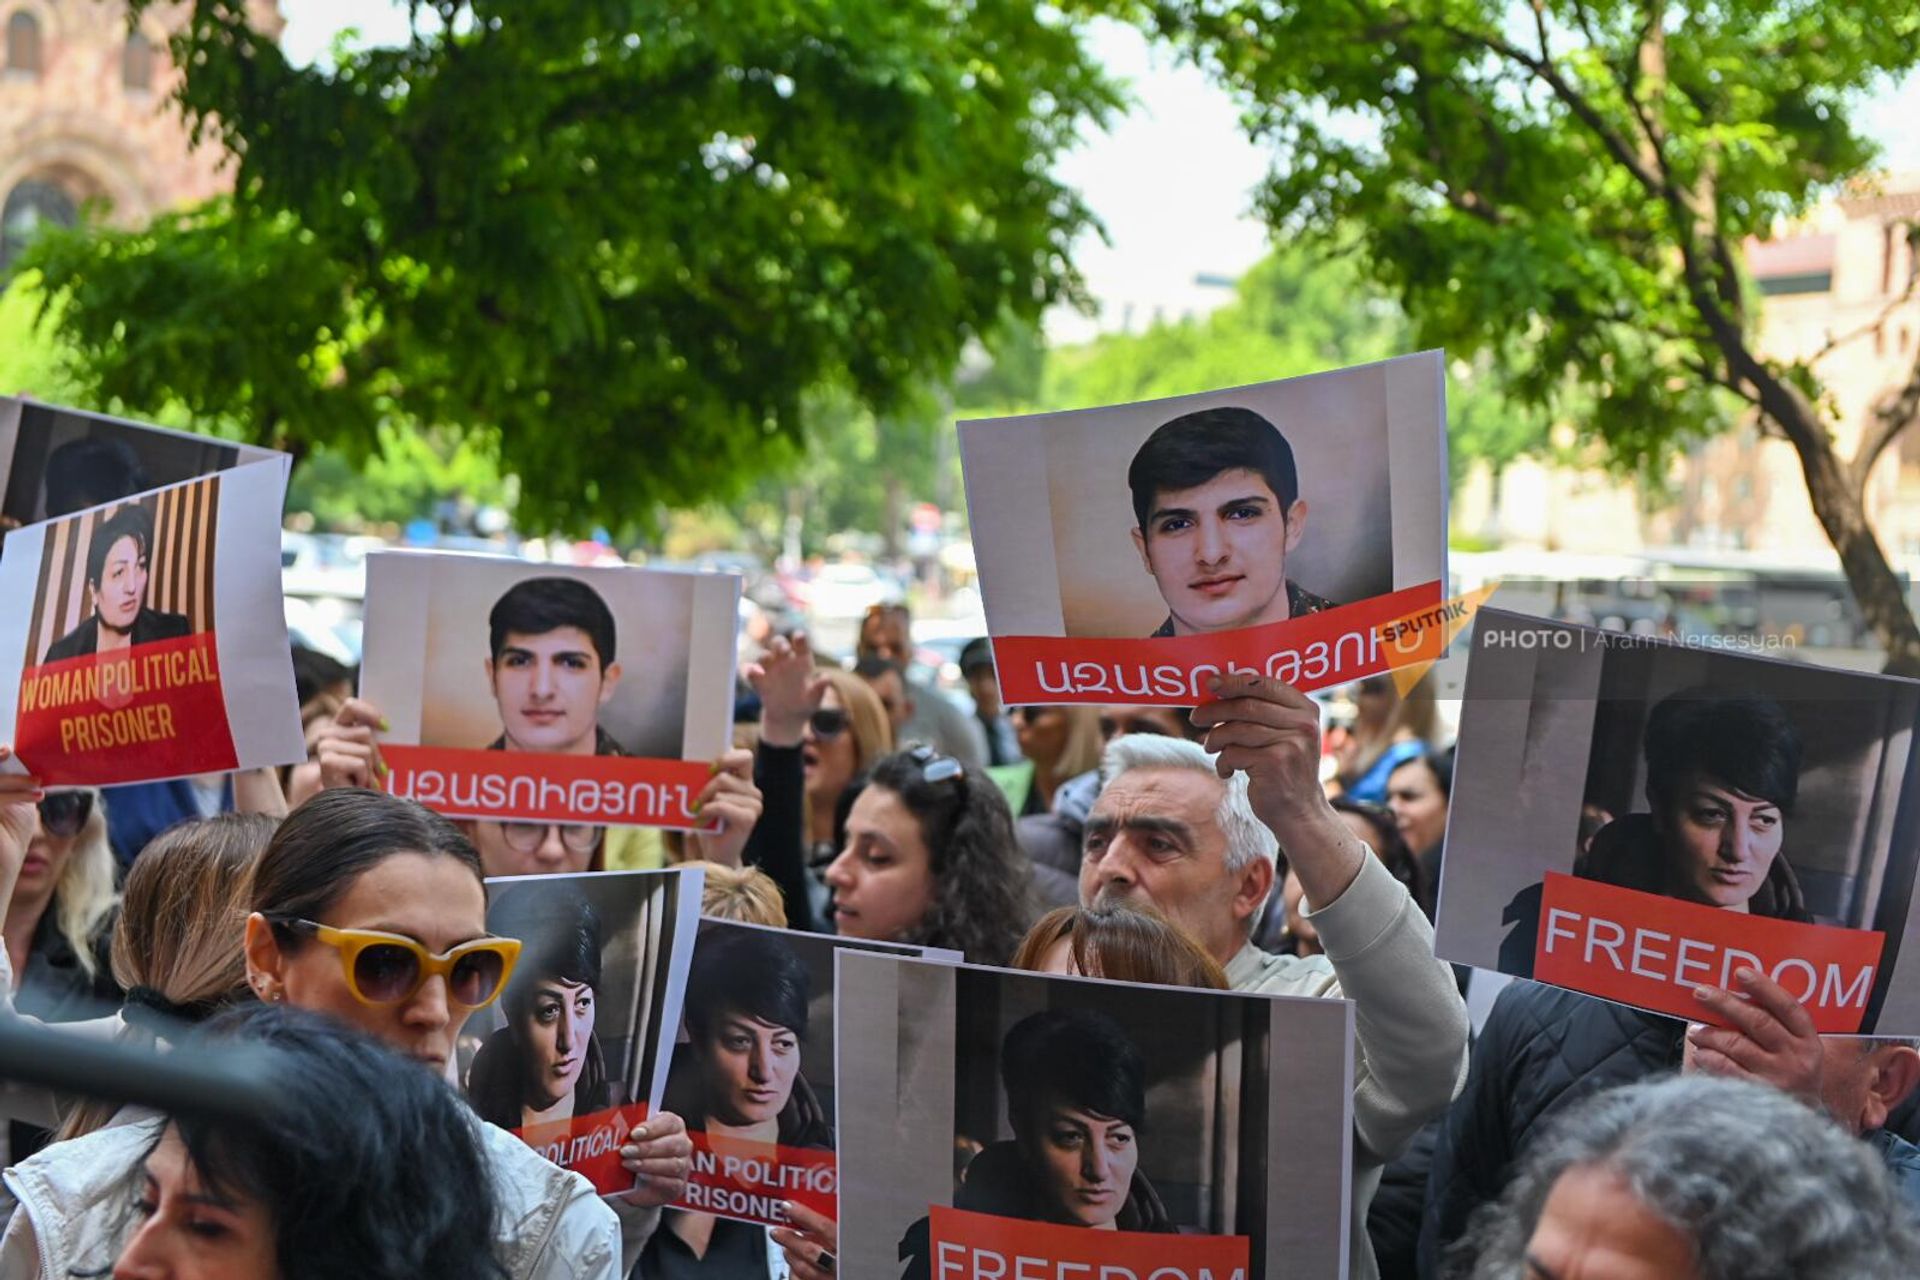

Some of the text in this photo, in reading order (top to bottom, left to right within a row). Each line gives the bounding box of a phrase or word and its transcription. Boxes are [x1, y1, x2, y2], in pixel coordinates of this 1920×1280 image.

[21, 646, 217, 713] WOMAN POLITICAL
[60, 703, 176, 754] PRISONER
[1545, 907, 1874, 1008] FREEDOM
[724, 1155, 838, 1194] POLITIC
[687, 1182, 793, 1223] RISONE
